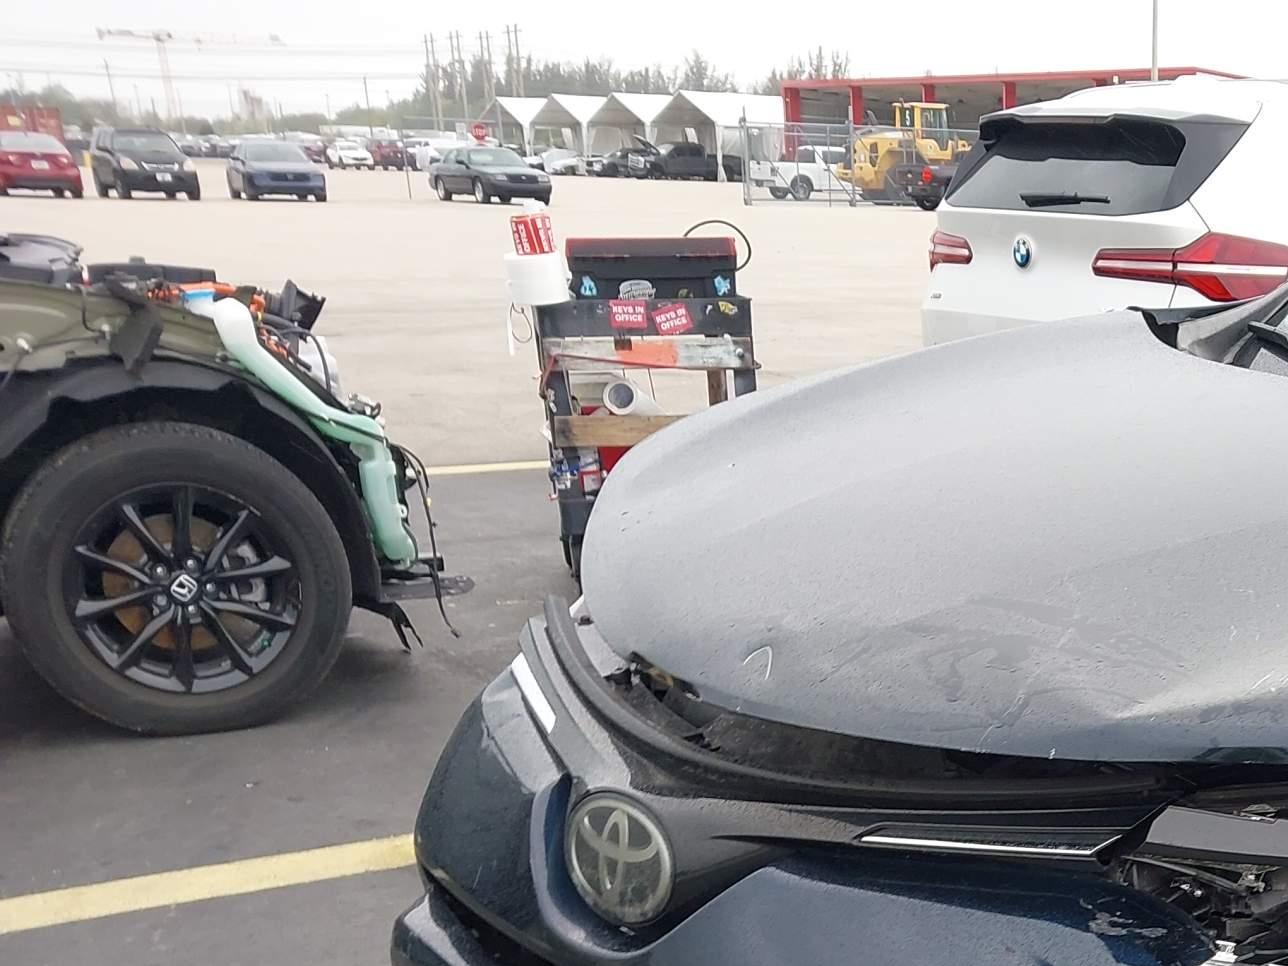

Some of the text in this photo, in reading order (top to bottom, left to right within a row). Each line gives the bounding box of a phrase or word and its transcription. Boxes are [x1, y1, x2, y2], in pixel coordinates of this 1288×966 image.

[612, 305, 645, 314] KEYS IN
[614, 313, 643, 322] OFFICE
[655, 308, 687, 324] KEYS IN
[660, 316, 688, 330] OFFICE
